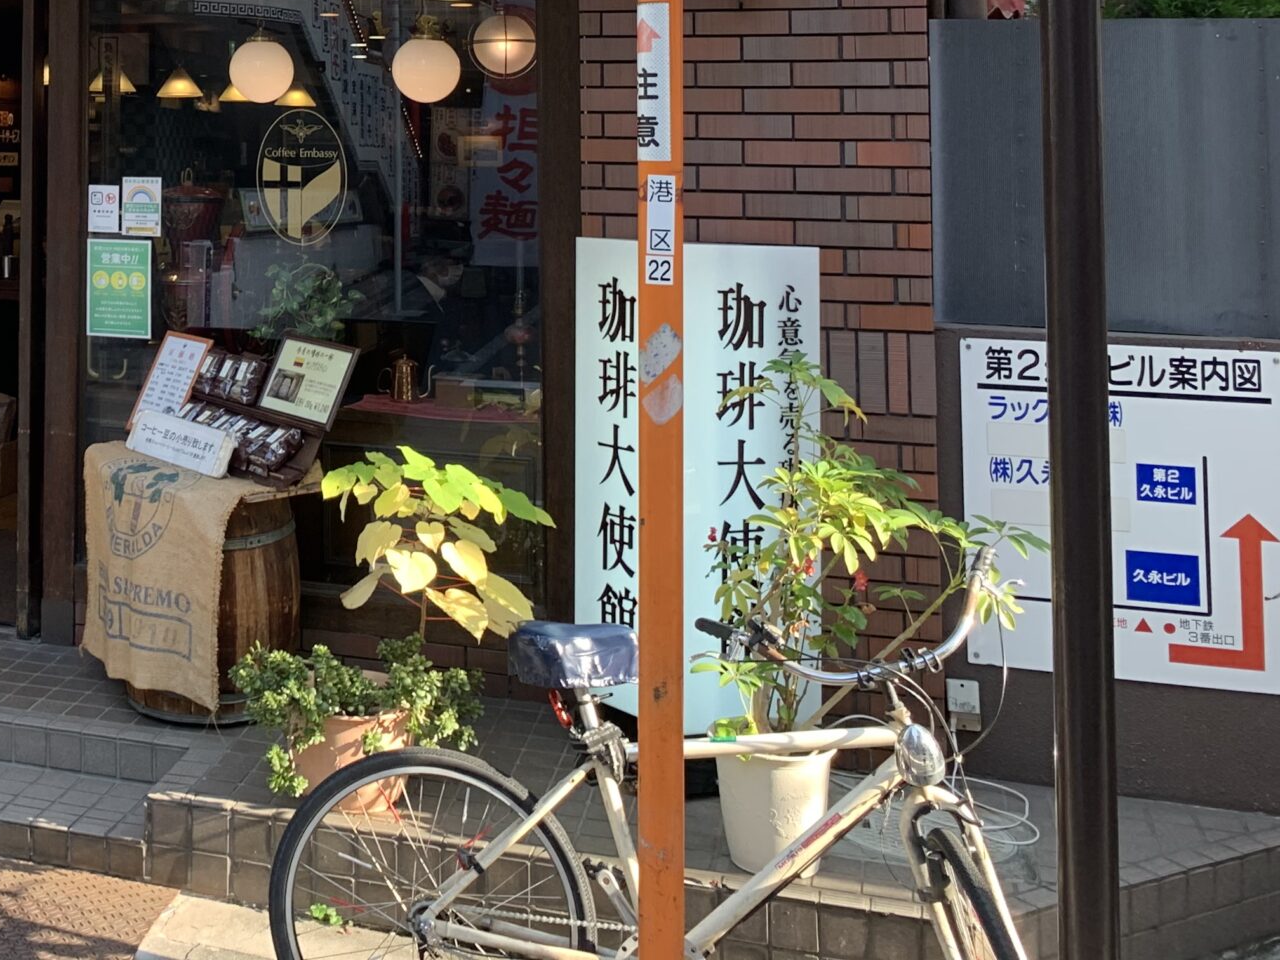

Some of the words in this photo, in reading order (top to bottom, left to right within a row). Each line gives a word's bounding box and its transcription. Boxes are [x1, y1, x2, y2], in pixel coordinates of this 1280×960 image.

[265, 146, 296, 158] Coffee
[299, 146, 339, 161] Embassy
[648, 179, 673, 253] 港区
[648, 259, 672, 282] 22
[985, 345, 1262, 392] 第2ビル案内図
[1153, 468, 1180, 483] 第2
[1140, 484, 1193, 501] 久永ビル
[111, 522, 163, 555] ERILDA
[1133, 569, 1191, 587] 久永ビル
[113, 576, 192, 614] SUPREMO
[1179, 617, 1215, 632] 地下鉄
[1188, 630, 1236, 646] 3番出口
